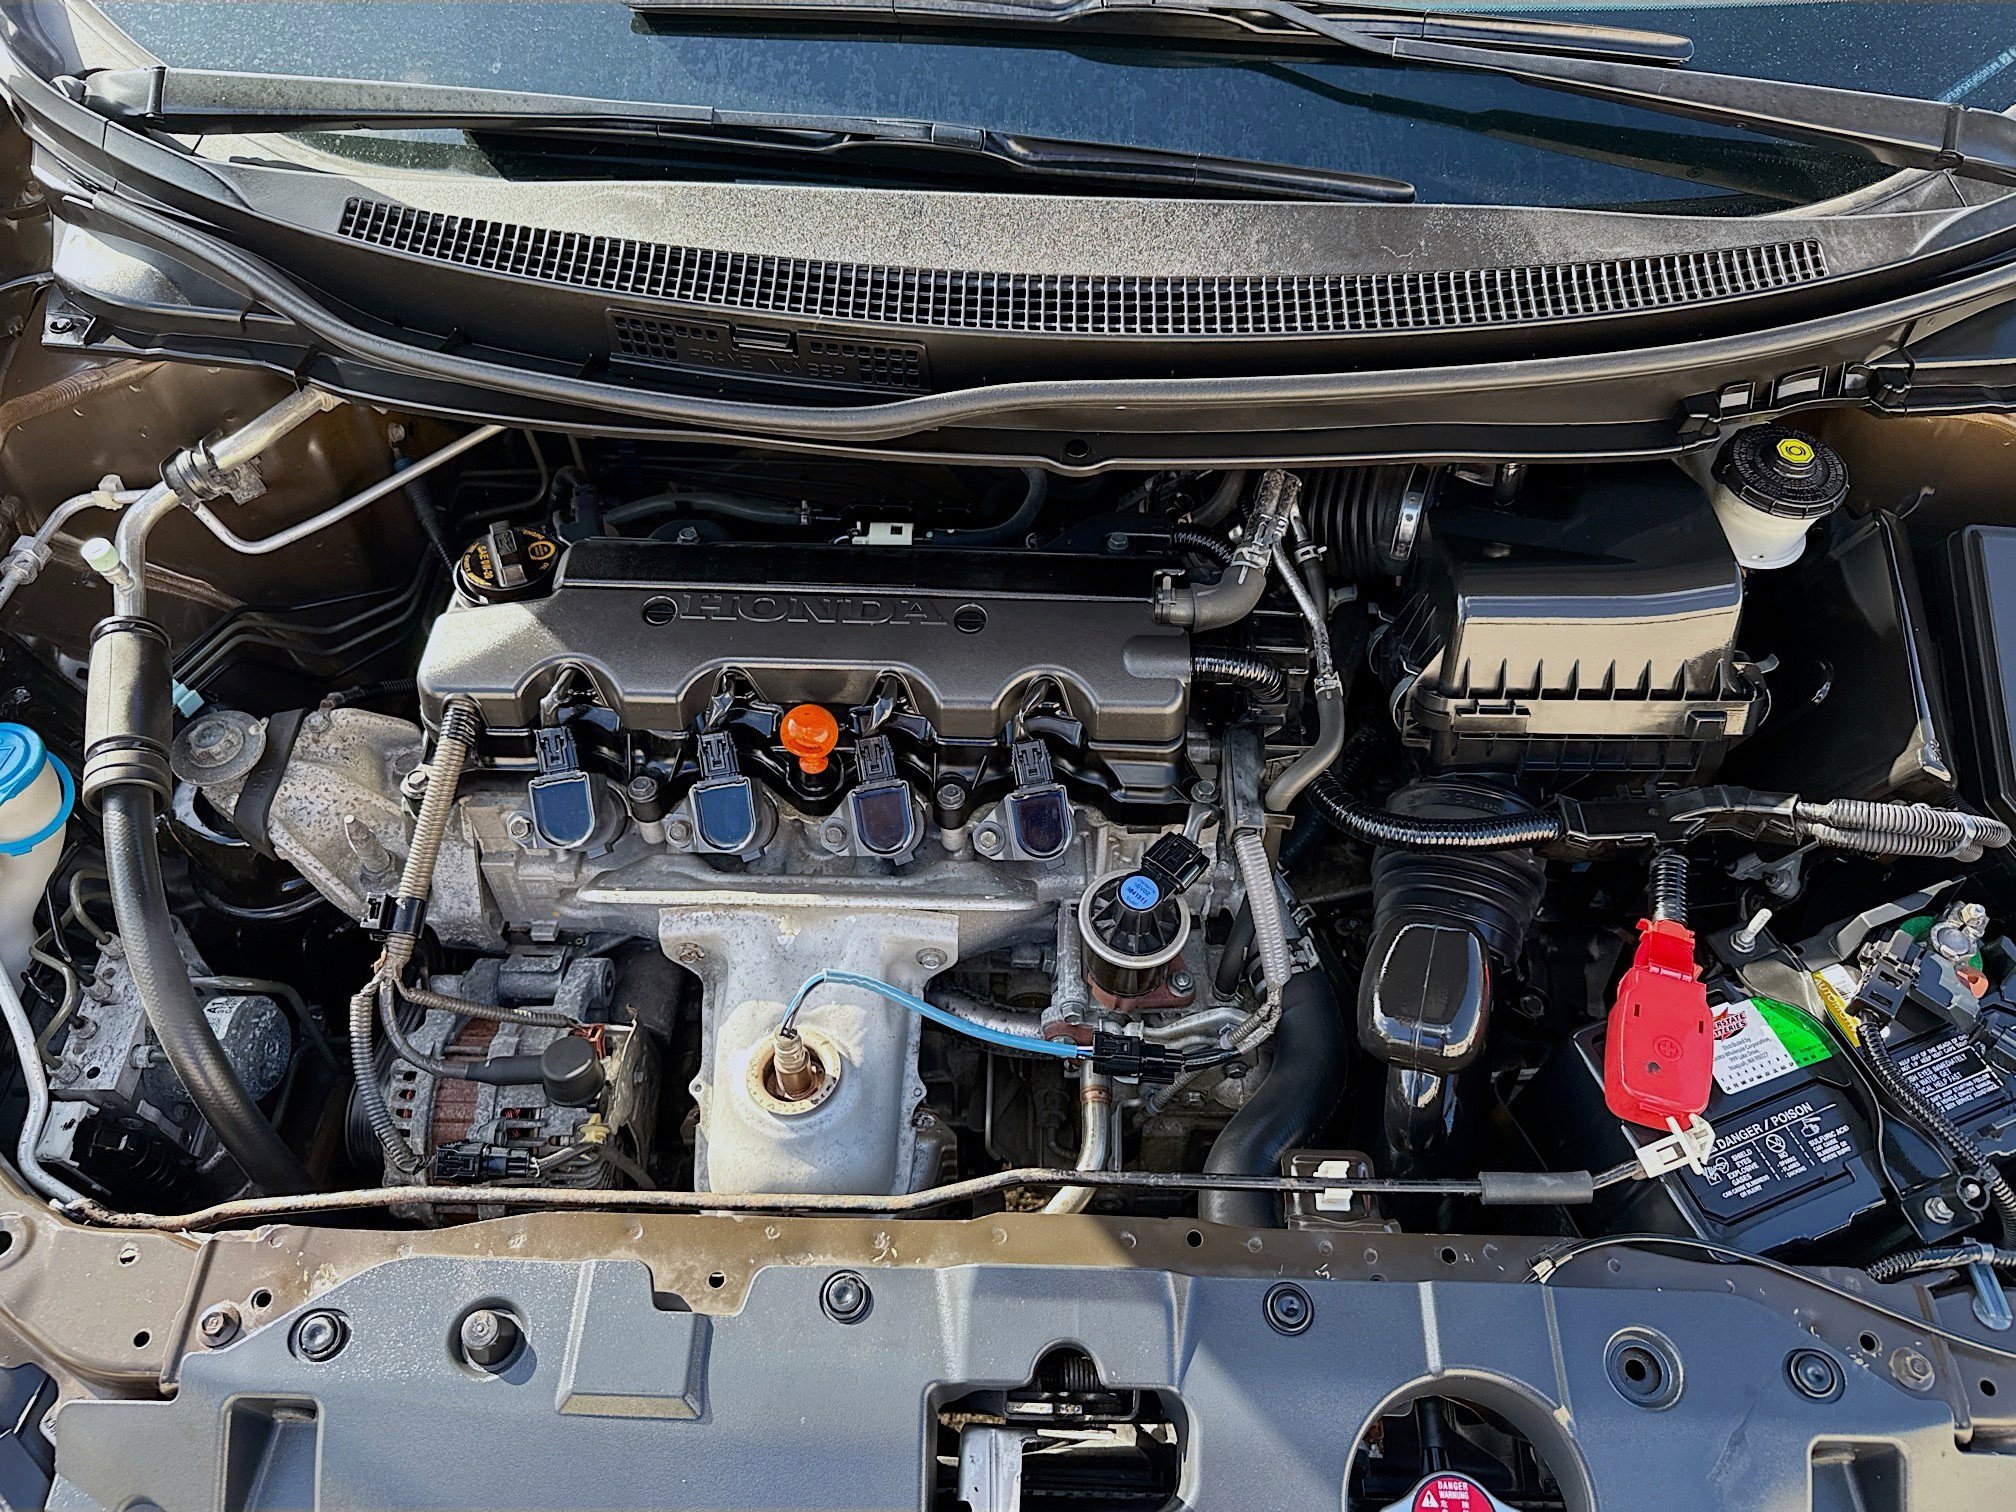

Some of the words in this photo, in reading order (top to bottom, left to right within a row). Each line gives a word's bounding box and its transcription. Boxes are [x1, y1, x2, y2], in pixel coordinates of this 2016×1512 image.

[478, 545, 490, 560] SAE
[680, 594, 948, 625] HONDA
[1713, 1020, 1747, 1038] TTERIES
[1910, 1053, 1921, 1061] OUT
[1927, 1046, 1938, 1055] THE
[1917, 1068, 1933, 1079] EYES
[1932, 1053, 1967, 1073] IMMEDIATELY
[1939, 1068, 1952, 1078] GET
[1933, 1078, 1948, 1089] HELP
[1947, 1071, 1963, 1083] FAST
[1716, 1123, 1764, 1150] DANGER
[1769, 1101, 1814, 1127] POISON
[1808, 1130, 1837, 1147] SULFURIC
[1836, 1124, 1850, 1136] ACID
[1731, 1149, 1753, 1162] SHIELD
[1778, 1151, 1789, 1160] NO
[1813, 1144, 1824, 1153] CAN
[1735, 1157, 1752, 1169] EYES
[1727, 1162, 1760, 1180] EXPLOSIVE
[1732, 1173, 1753, 1186] GASES
[1722, 1190, 1733, 1199] CAN
[1437, 1481, 1469, 1491] DANGER
